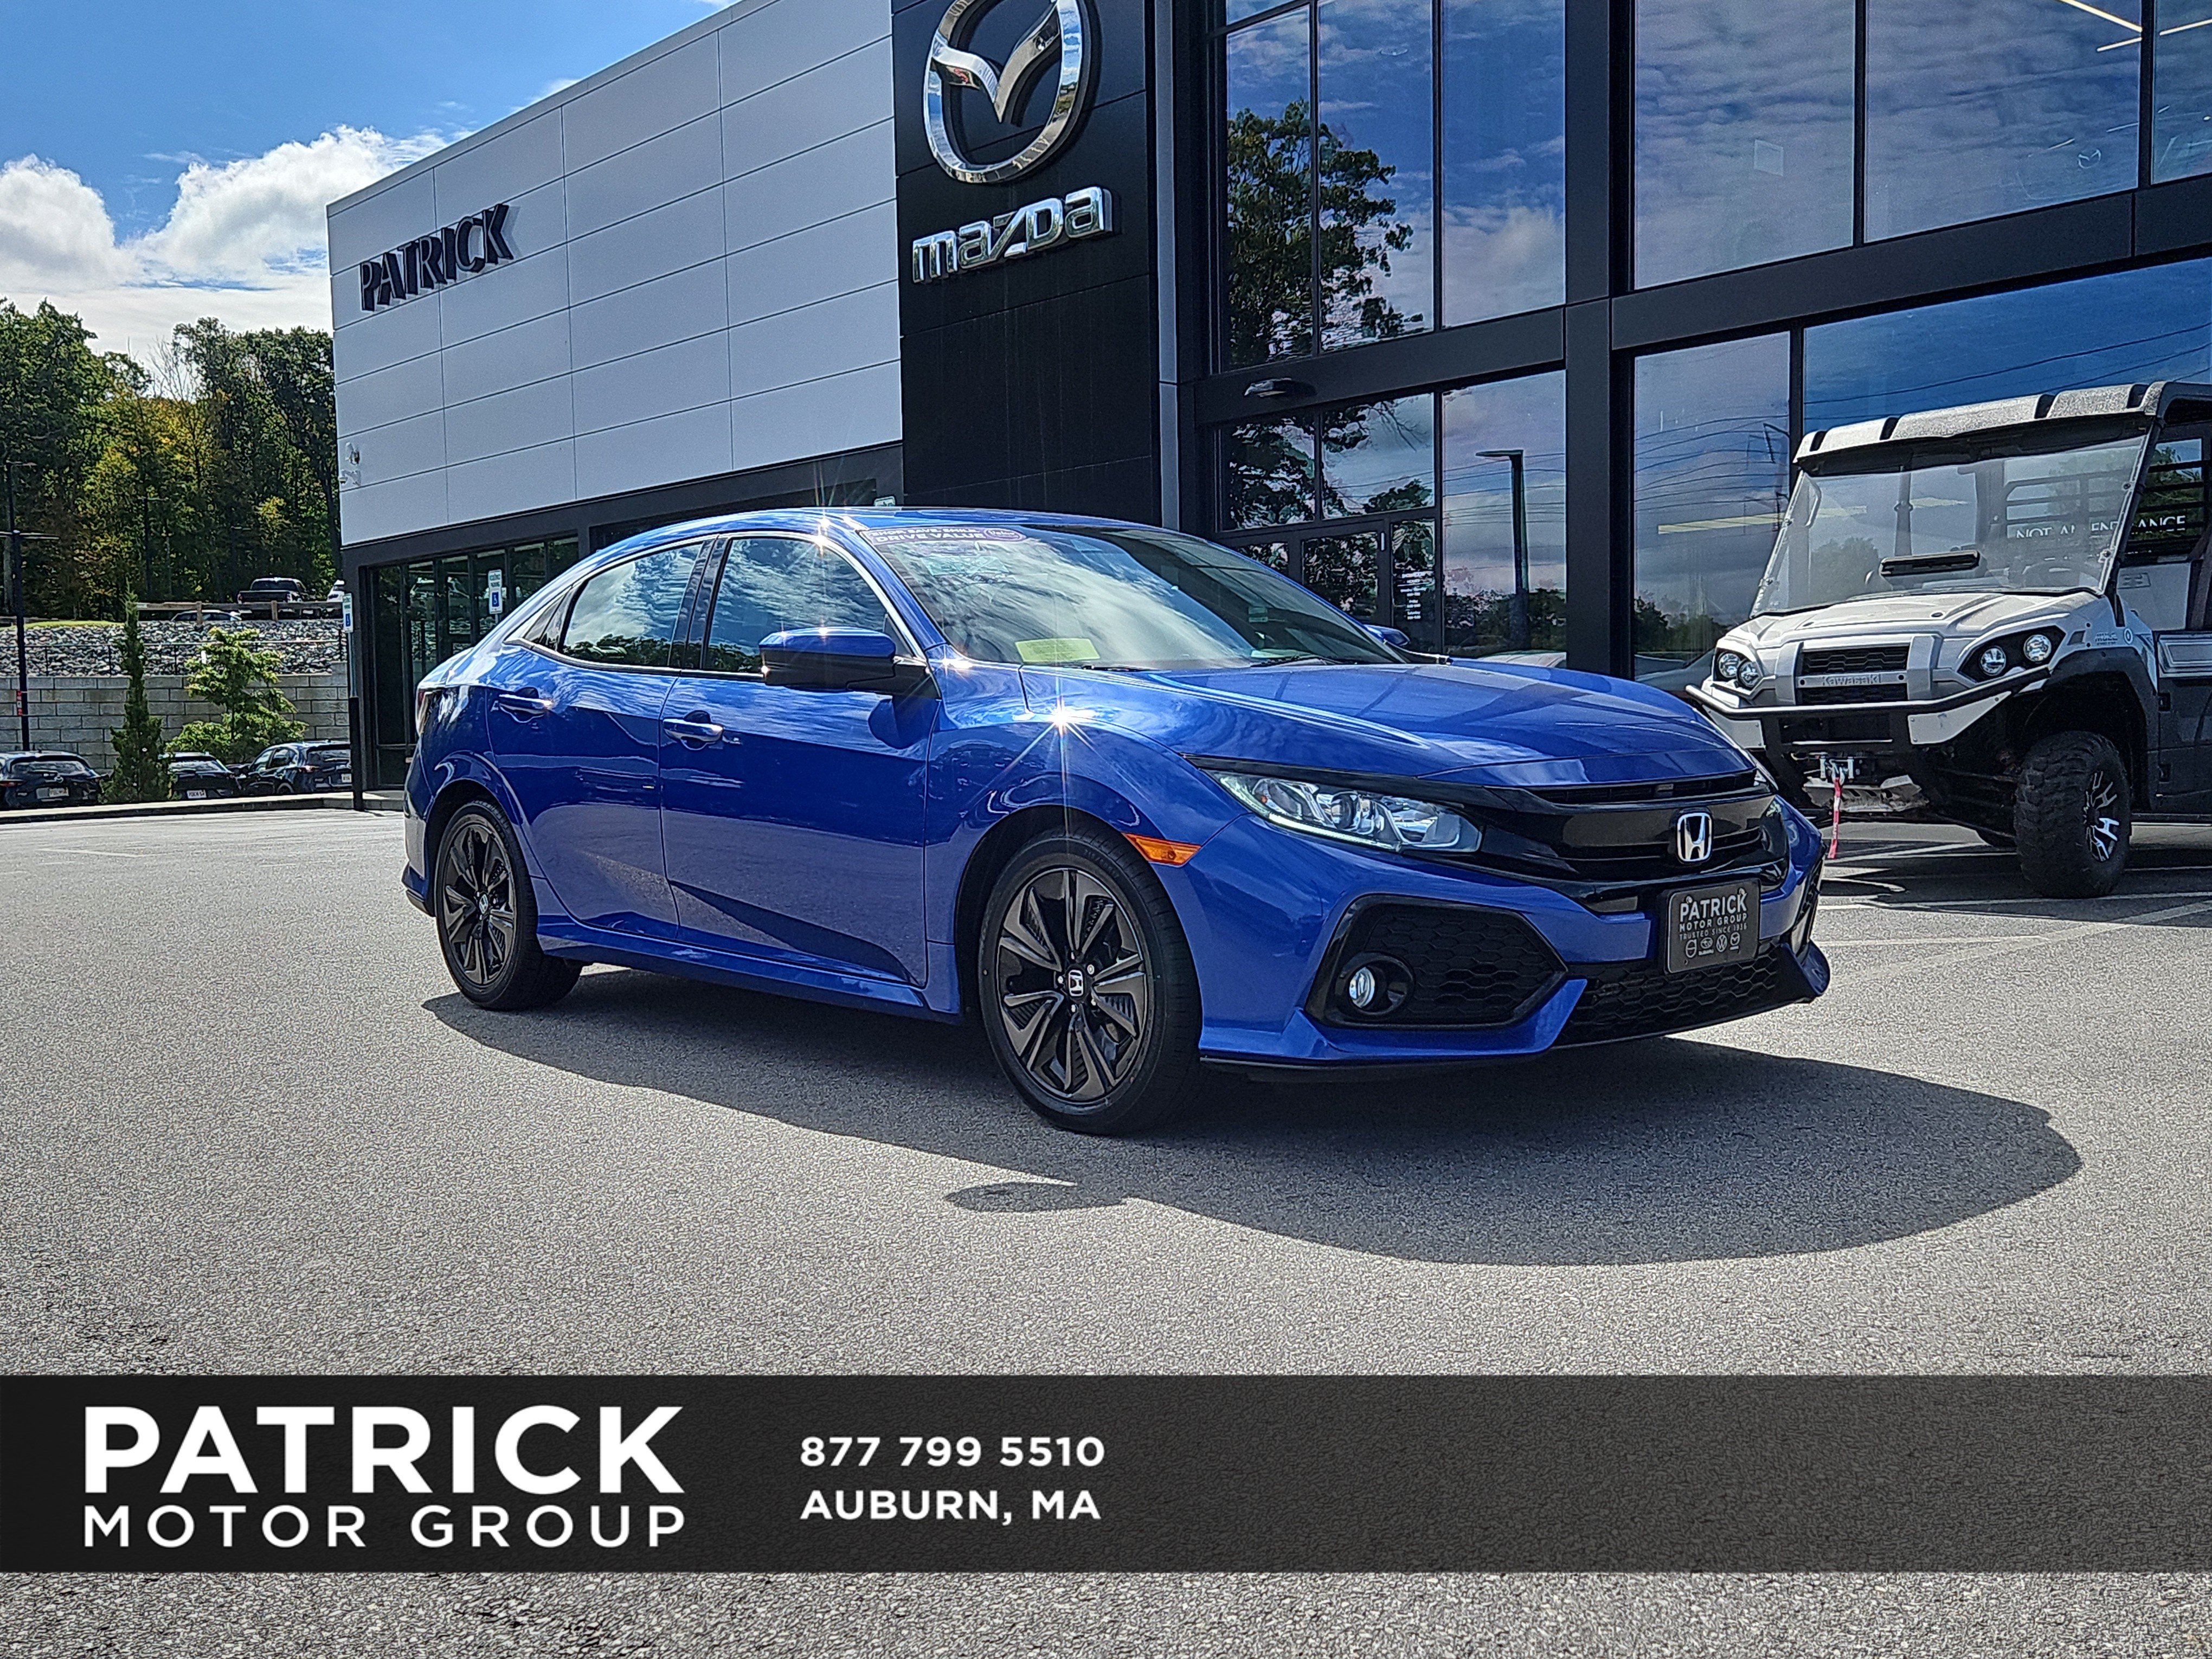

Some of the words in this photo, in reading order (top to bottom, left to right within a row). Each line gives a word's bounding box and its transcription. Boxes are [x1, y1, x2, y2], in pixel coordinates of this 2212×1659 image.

[913, 186, 1113, 282] mazda
[359, 203, 514, 311] PATRICK
[875, 533, 929, 542] DRIVE
[2089, 515, 2186, 538] ENANCE
[1680, 892, 1747, 922] PATRICK
[1679, 919, 1712, 933] MOTOR
[1716, 912, 1747, 926] GROUP
[1679, 929, 1709, 941] TRUSTED
[1712, 925, 1731, 935] SINCE
